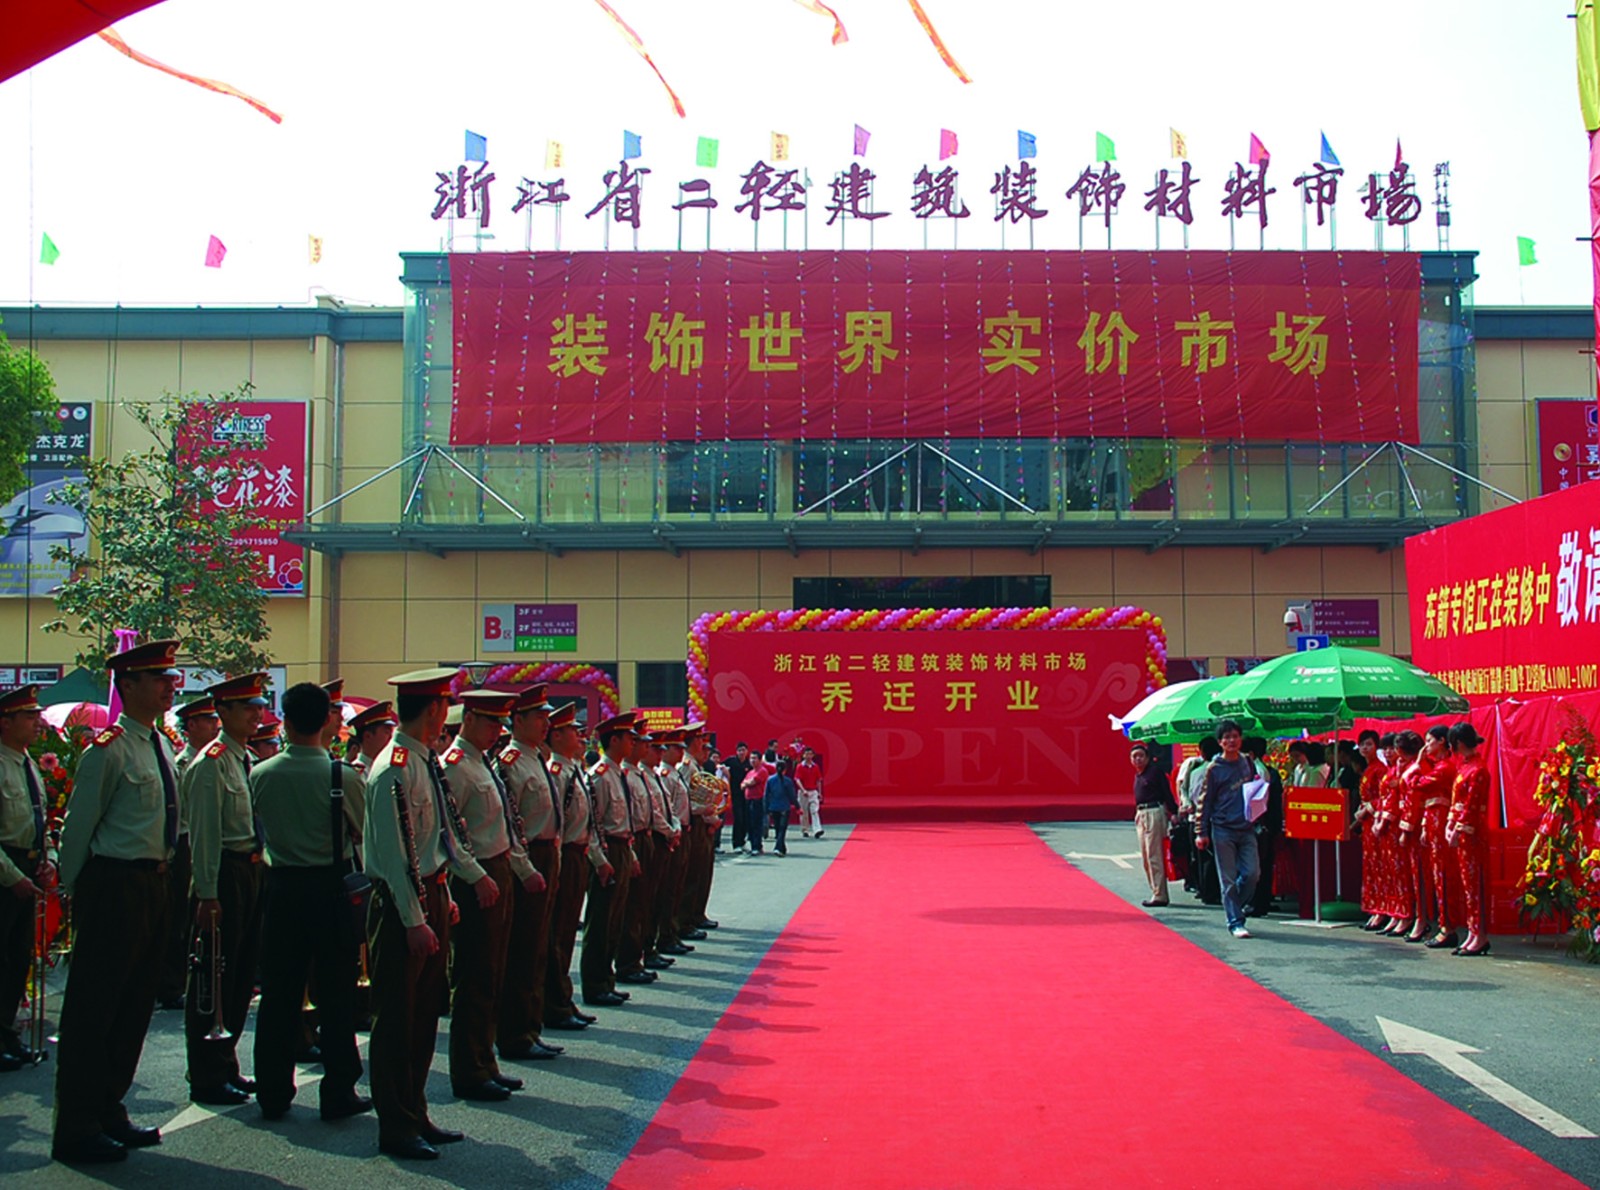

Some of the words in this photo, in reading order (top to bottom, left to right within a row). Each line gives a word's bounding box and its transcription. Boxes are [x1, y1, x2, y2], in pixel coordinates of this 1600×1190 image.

[548, 311, 899, 378] 装饰世界
[981, 310, 1328, 377] 实价市场
[36, 434, 85, 448] 杰克龙
[1424, 562, 1550, 639] 东箭专馆正在装修中
[1306, 639, 1320, 651] P
[774, 652, 1087, 673] 浙江省二轻建筑装饰材料市场
[821, 681, 1039, 712] 乔迁开业
[776, 725, 1088, 788] OPEN
